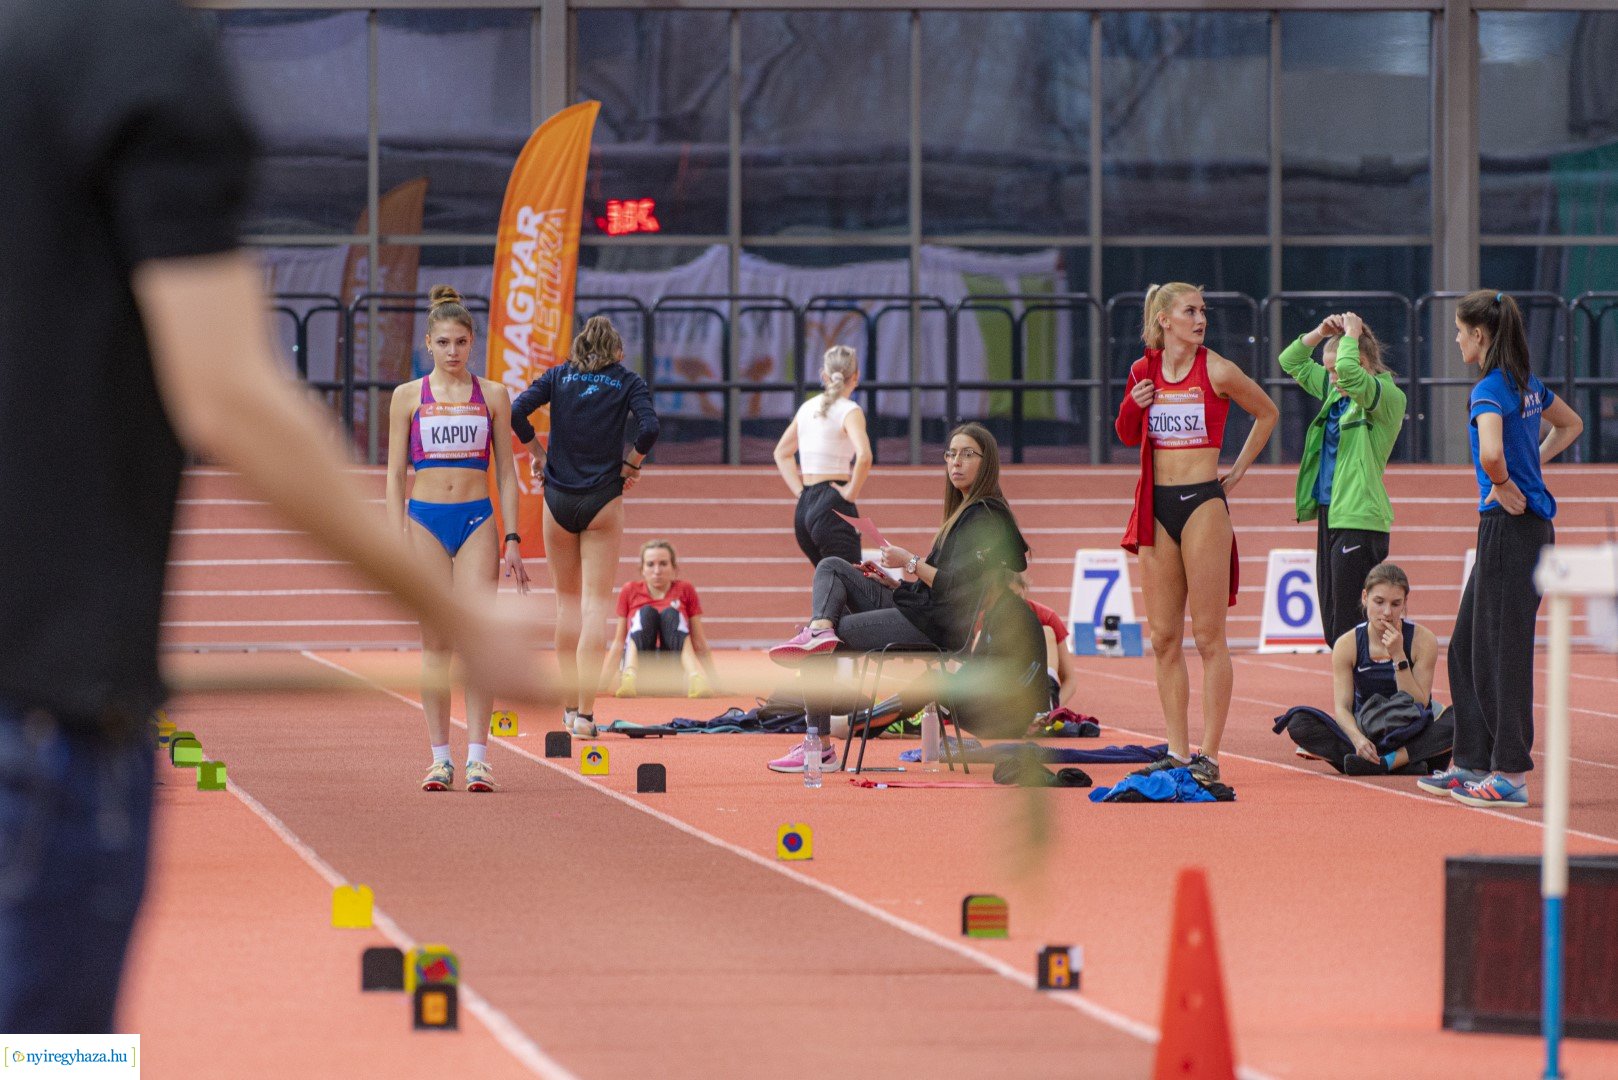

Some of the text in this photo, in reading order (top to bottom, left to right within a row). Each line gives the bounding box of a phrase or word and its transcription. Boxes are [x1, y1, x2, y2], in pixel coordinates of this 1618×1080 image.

[431, 425, 478, 445] KAPUY
[1147, 412, 1204, 433] SZŰCS SZ.
[1083, 569, 1120, 628] 7
[1277, 569, 1314, 628] 6
